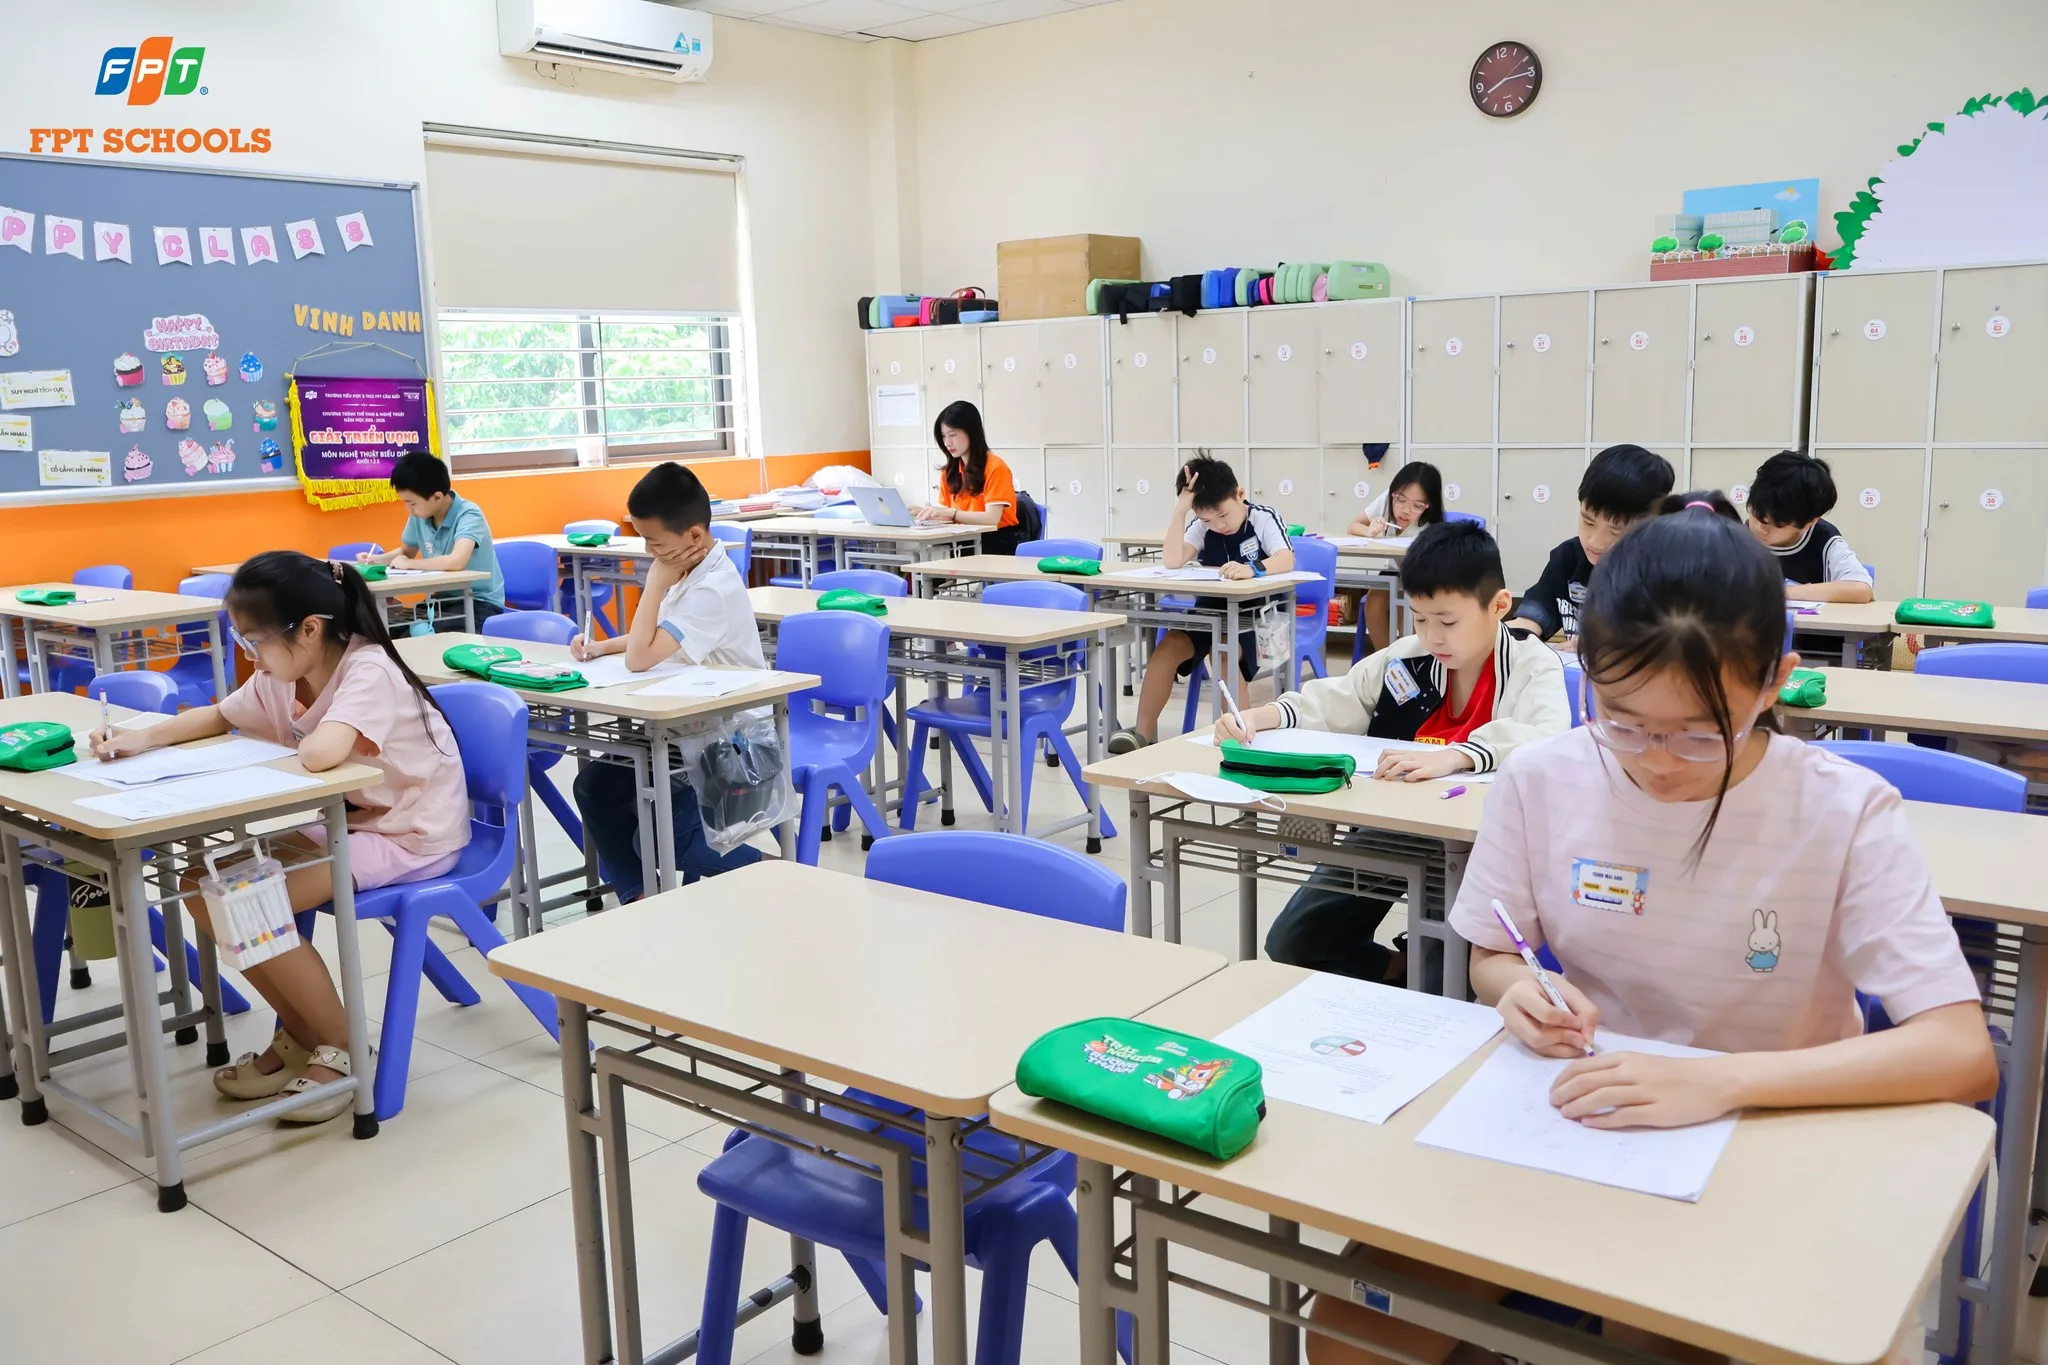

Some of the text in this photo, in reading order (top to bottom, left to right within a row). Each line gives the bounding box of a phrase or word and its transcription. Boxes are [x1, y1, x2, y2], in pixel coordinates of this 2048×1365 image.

[1496, 47, 1508, 60] 12
[1528, 66, 1536, 77] 3
[1476, 83, 1484, 93] 9
[1504, 101, 1513, 112] 6
[162, 221, 364, 258] CLASS
[155, 317, 202, 332] HAPPY
[293, 303, 420, 337] VINH DANH
[148, 334, 218, 350] BIRTHDAY
[309, 425, 419, 447] GIẢI TRIỂN VỌNG
[339, 450, 358, 458] NGHỆ
